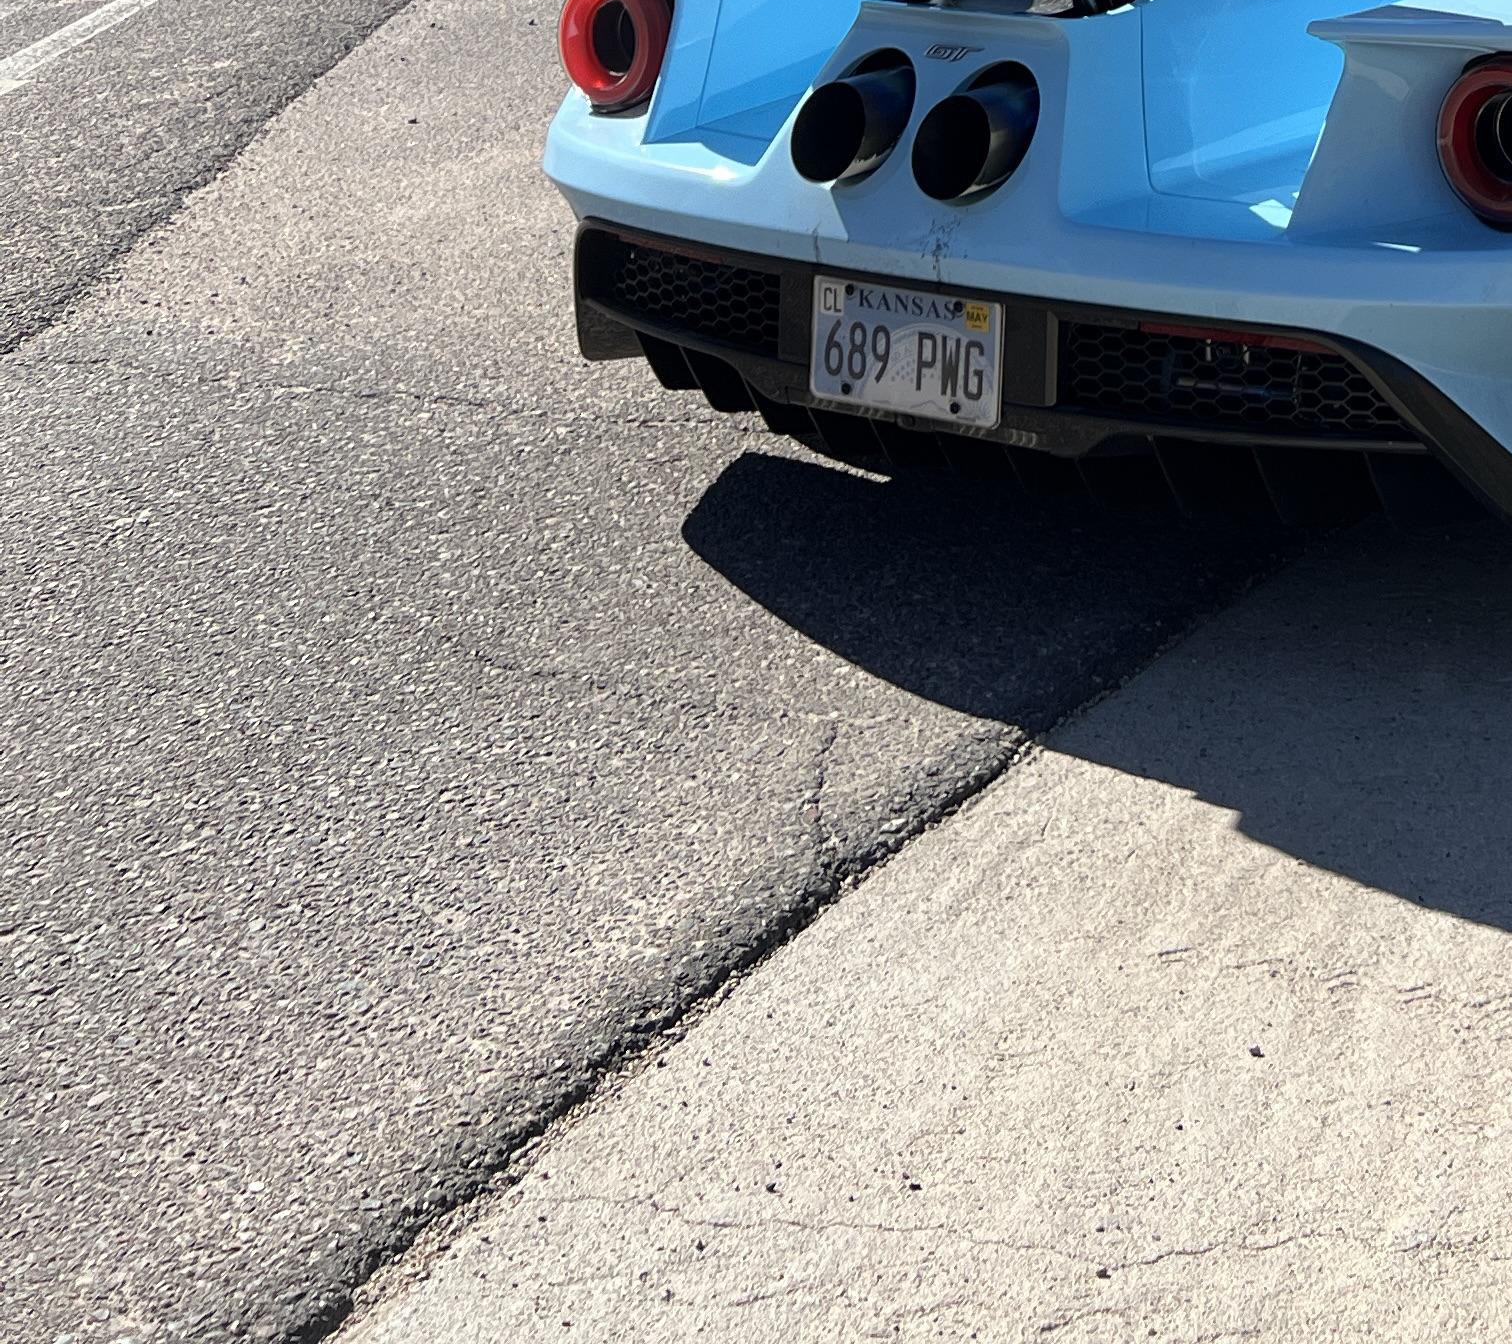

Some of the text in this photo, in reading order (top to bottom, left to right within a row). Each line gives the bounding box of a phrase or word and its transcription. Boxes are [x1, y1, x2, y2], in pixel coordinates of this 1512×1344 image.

[823, 286, 843, 313] CL
[858, 288, 957, 322] KANSAS
[966, 310, 988, 323] MAY
[823, 319, 985, 401] 689 PWG
